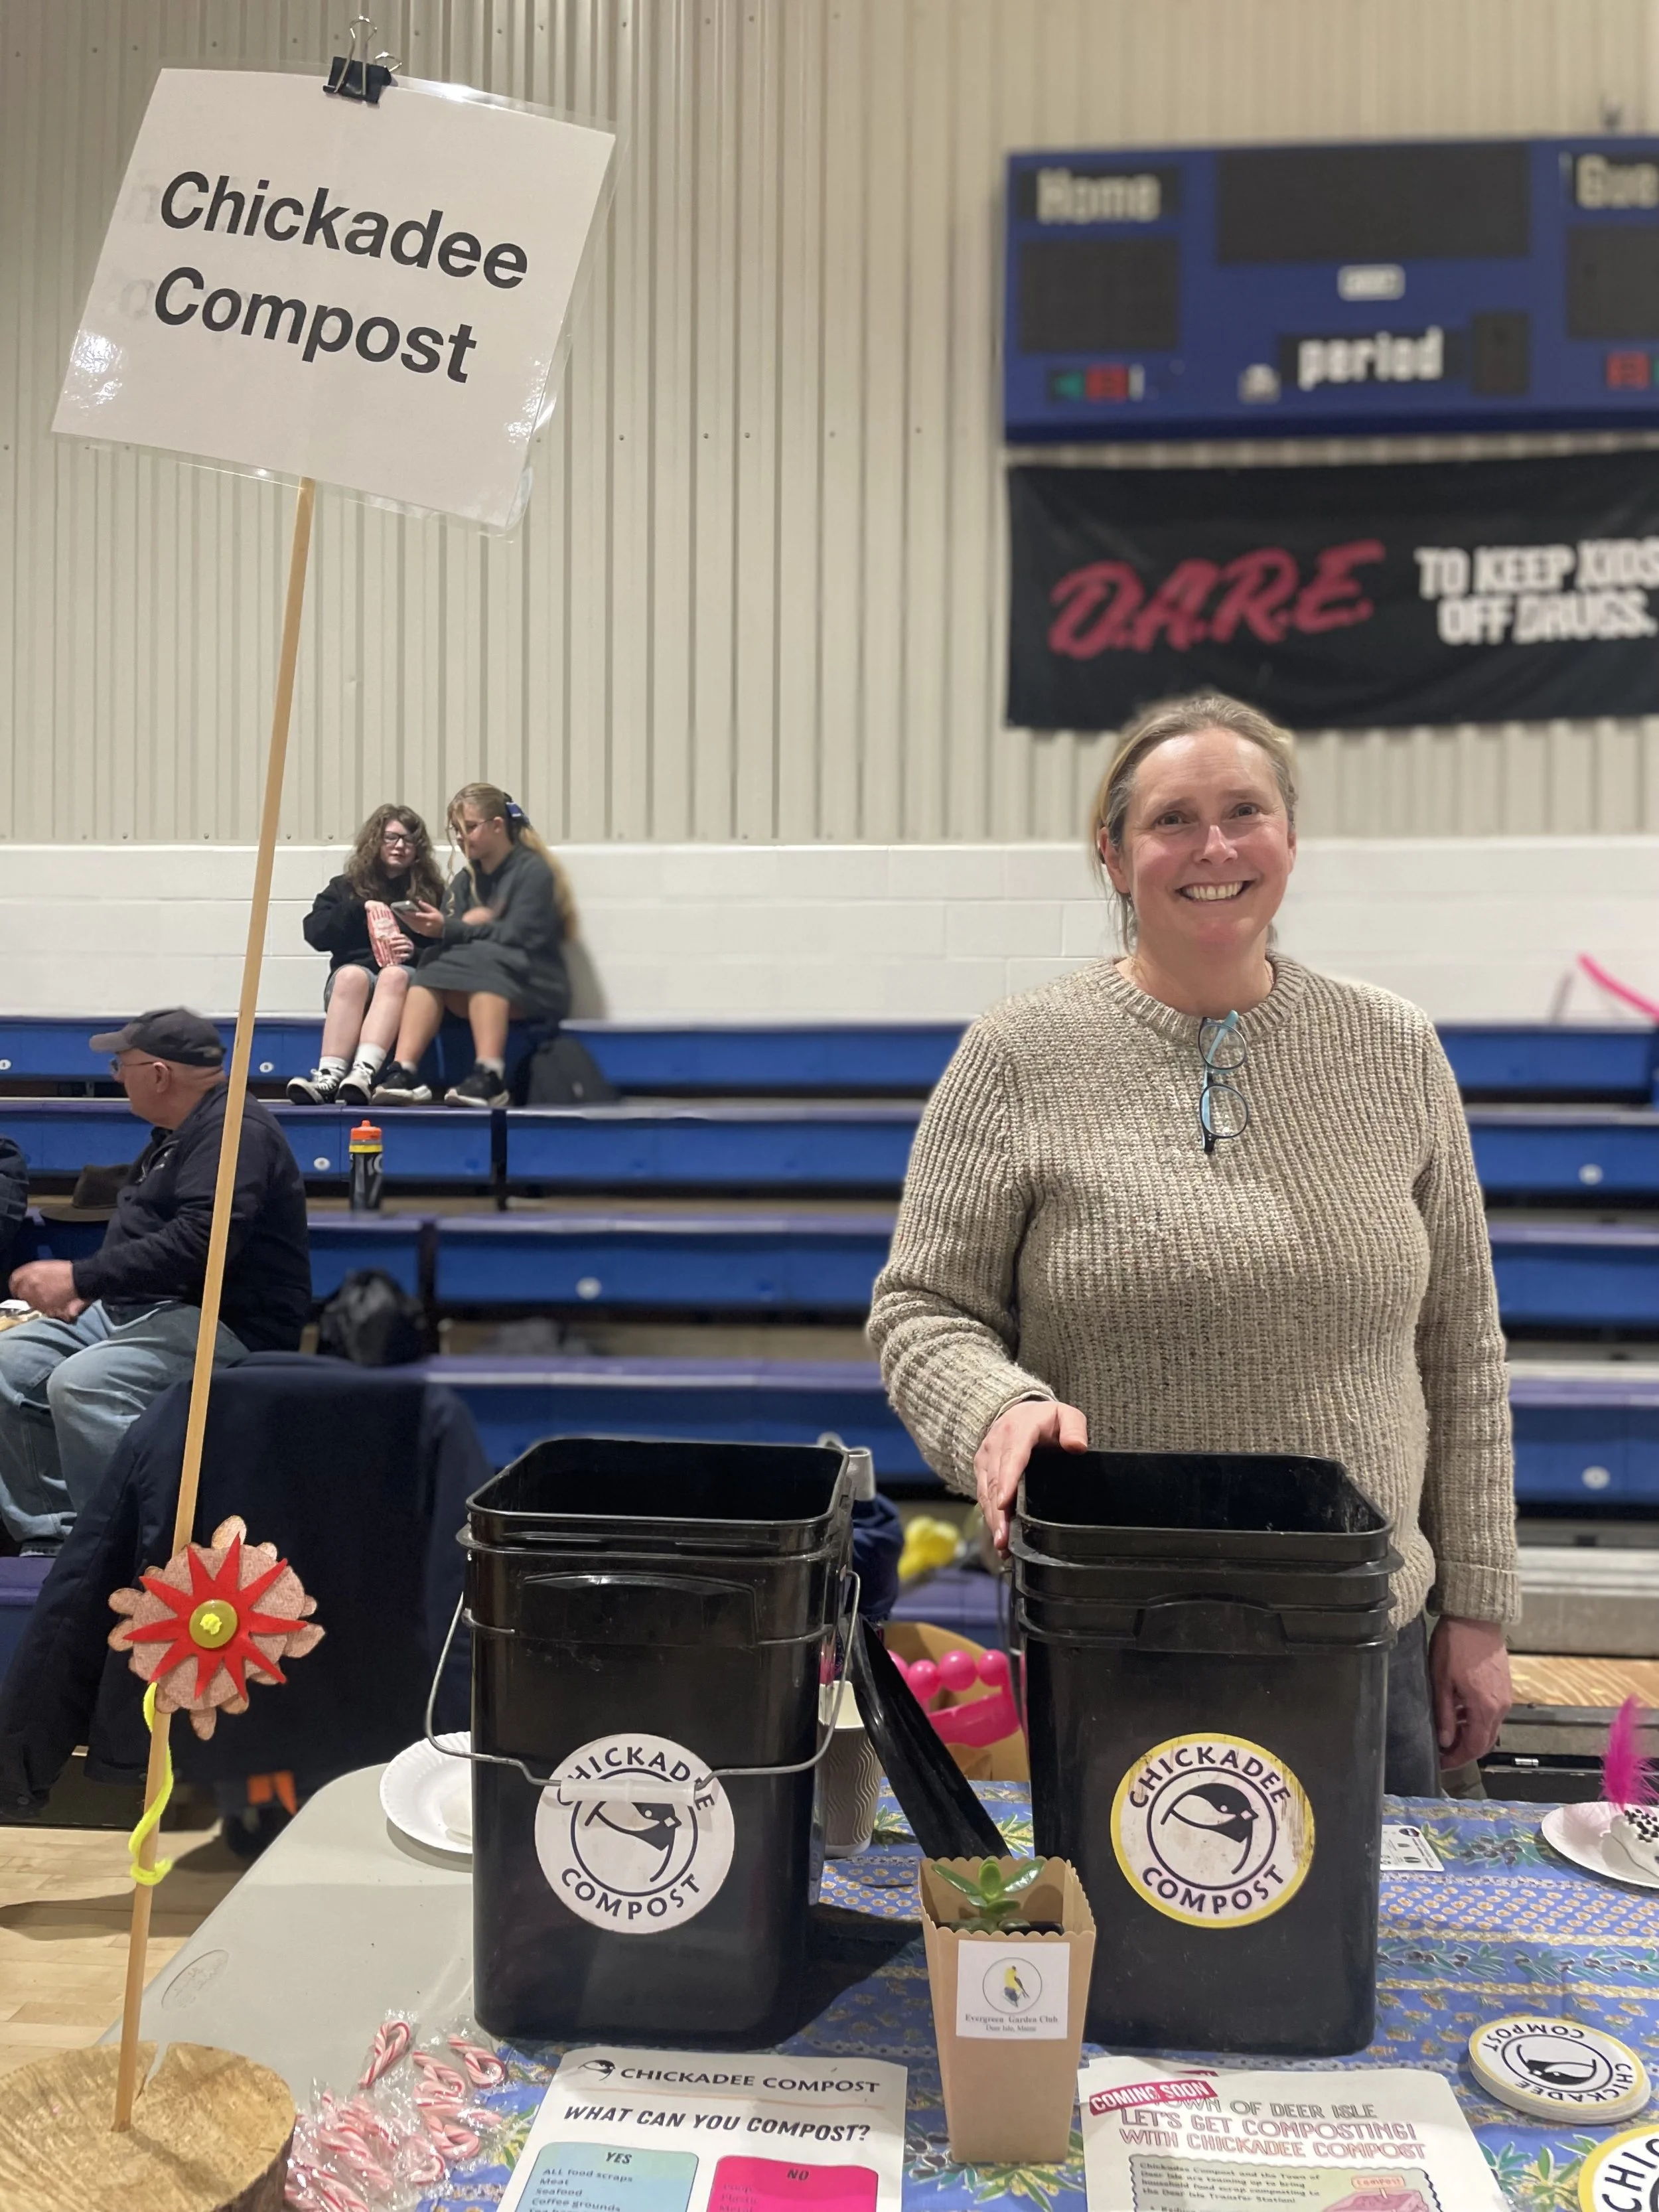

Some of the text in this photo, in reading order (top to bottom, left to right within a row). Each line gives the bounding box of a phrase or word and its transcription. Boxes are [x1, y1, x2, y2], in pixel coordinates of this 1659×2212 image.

[1037, 168, 1160, 224] Home
[160, 171, 528, 289] Chickadee
[155, 267, 478, 384] Compost
[1299, 325, 1443, 391] period
[1415, 546, 1467, 598] TO
[1473, 544, 1574, 595] KEEP
[1437, 589, 1657, 644] OFF DRUGS.
[1129, 1746, 1291, 1807] CHICKADEE
[562, 1868, 700, 1919] COMPOST
[1142, 1864, 1283, 1914] COMPOST
[965, 2014, 1004, 2024] Evergreen
[1009, 2014, 1037, 2023] Garden
[1482, 2023, 1585, 2053] COMPOST
[620, 2068, 880, 2093] CHICKADEE COMPOST
[1090, 2081, 1210, 2112] COMING SOON
[1516, 2063, 1633, 2103] CHICKADEE
[563, 2106, 871, 2142] WHAT CAN YOU COMPOST?
[1121, 2108, 1183, 2128] LET'S
[1191, 2114, 1232, 2133] GET
[1230, 2100, 1262, 2115] OF
[1270, 2102, 1325, 2118] DEER
[1331, 2104, 1378, 2119] ISLE
[605, 2152, 632, 2164] YES
[1119, 2128, 1425, 2160] WITH CHICKADEE COMPOST
[567, 2169, 594, 2177] food
[597, 2172, 633, 2183] scraps
[787, 2168, 810, 2181] NO
[532, 2197, 621, 2212] Coffee grounds
[536, 2187, 583, 2197] Seafood
